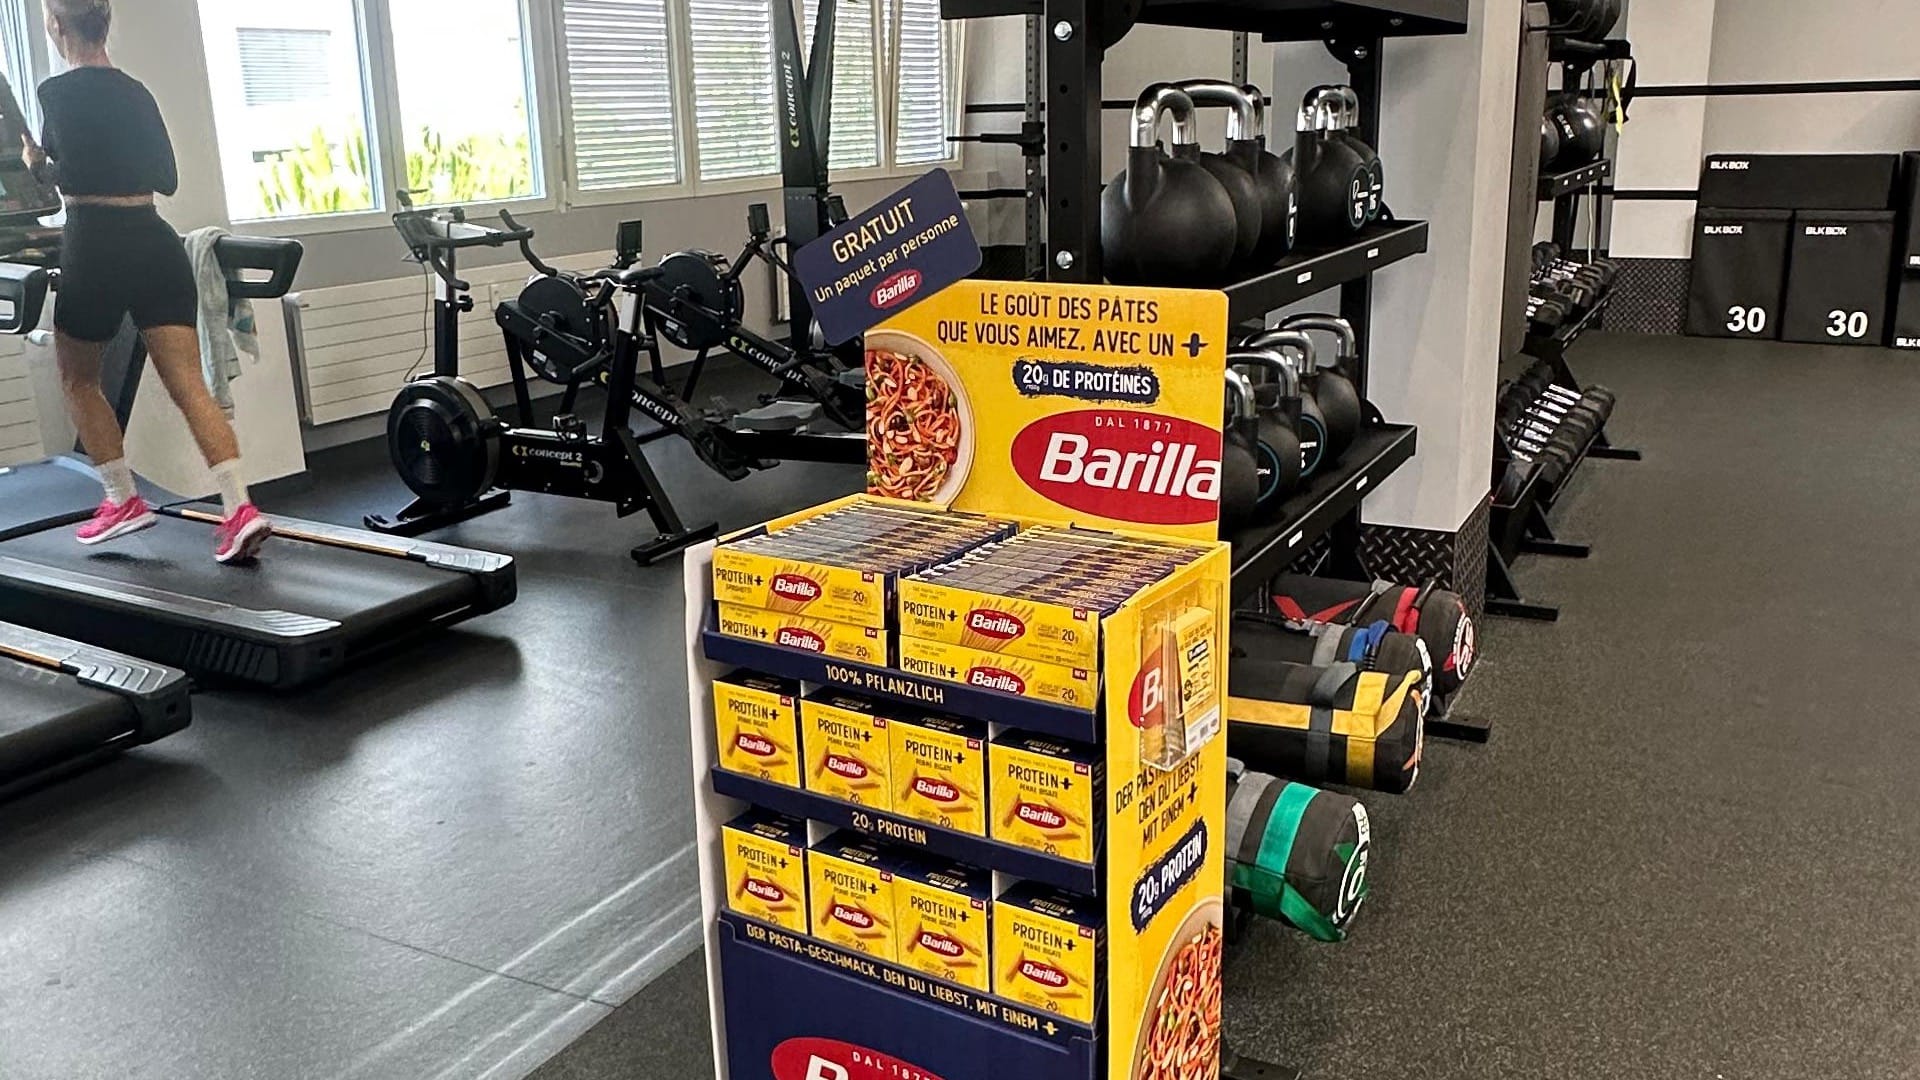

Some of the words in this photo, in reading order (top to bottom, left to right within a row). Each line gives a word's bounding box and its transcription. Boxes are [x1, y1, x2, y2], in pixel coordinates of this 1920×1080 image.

[1729, 161, 1749, 170] BOX
[832, 199, 915, 264] GRATUIT
[1723, 225, 1743, 234] BOX
[1826, 226, 1847, 236] BOX
[814, 284, 834, 304] Un
[837, 260, 877, 298] paquet
[879, 248, 899, 274] par
[899, 214, 959, 262] personne
[876, 274, 917, 306] Barilla
[980, 293, 999, 315] LE
[1004, 291, 1050, 318] GOÛT
[1059, 297, 1091, 321] DES
[1098, 296, 1158, 324] PÂTES
[1726, 305, 1766, 333] 30
[1826, 309, 1868, 338] 30
[938, 320, 968, 344] QUE
[974, 322, 1020, 347] VOUS
[1092, 331, 1141, 354] AVEC
[1149, 334, 1175, 356] UN
[748, 347, 803, 383] concpt
[1053, 369, 1070, 388] DE
[1075, 370, 1152, 395] PROTÉINES
[632, 389, 679, 425] oncept
[1095, 416, 1125, 428] DAL
[1134, 418, 1172, 434] 1877
[529, 447, 573, 460] concept
[575, 452, 583, 461] 2
[1039, 431, 1220, 501] Barilla
[774, 578, 816, 597] Barilla
[971, 614, 1019, 635] Barilla
[780, 632, 820, 651] Barilla
[825, 664, 862, 685] 100%
[866, 673, 944, 704] PFLANZLICH
[971, 671, 1020, 692] Barilla
[738, 736, 772, 753] Barilla
[828, 757, 864, 776] Barilla
[916, 779, 954, 799] Barilla
[1115, 781, 1133, 815] DER
[1139, 796, 1156, 825] DEN
[1158, 779, 1171, 808] DU
[1019, 805, 1060, 825] Barilla
[1143, 817, 1158, 849] MIT
[1161, 793, 1185, 833] EINEM
[878, 819, 927, 846] PROTEIN
[1161, 830, 1203, 893] PROTEIN
[747, 881, 780, 899] Barilla
[834, 907, 869, 926] Barilla
[921, 934, 960, 955] Barilla
[746, 923, 766, 942] DER
[883, 968, 905, 987] DEN
[908, 976, 925, 994] DU
[977, 999, 998, 1018] MIT
[1002, 1007, 1039, 1031] EINEM
[1022, 963, 1064, 984] Barilla
[853, 1051, 884, 1070] DAL
